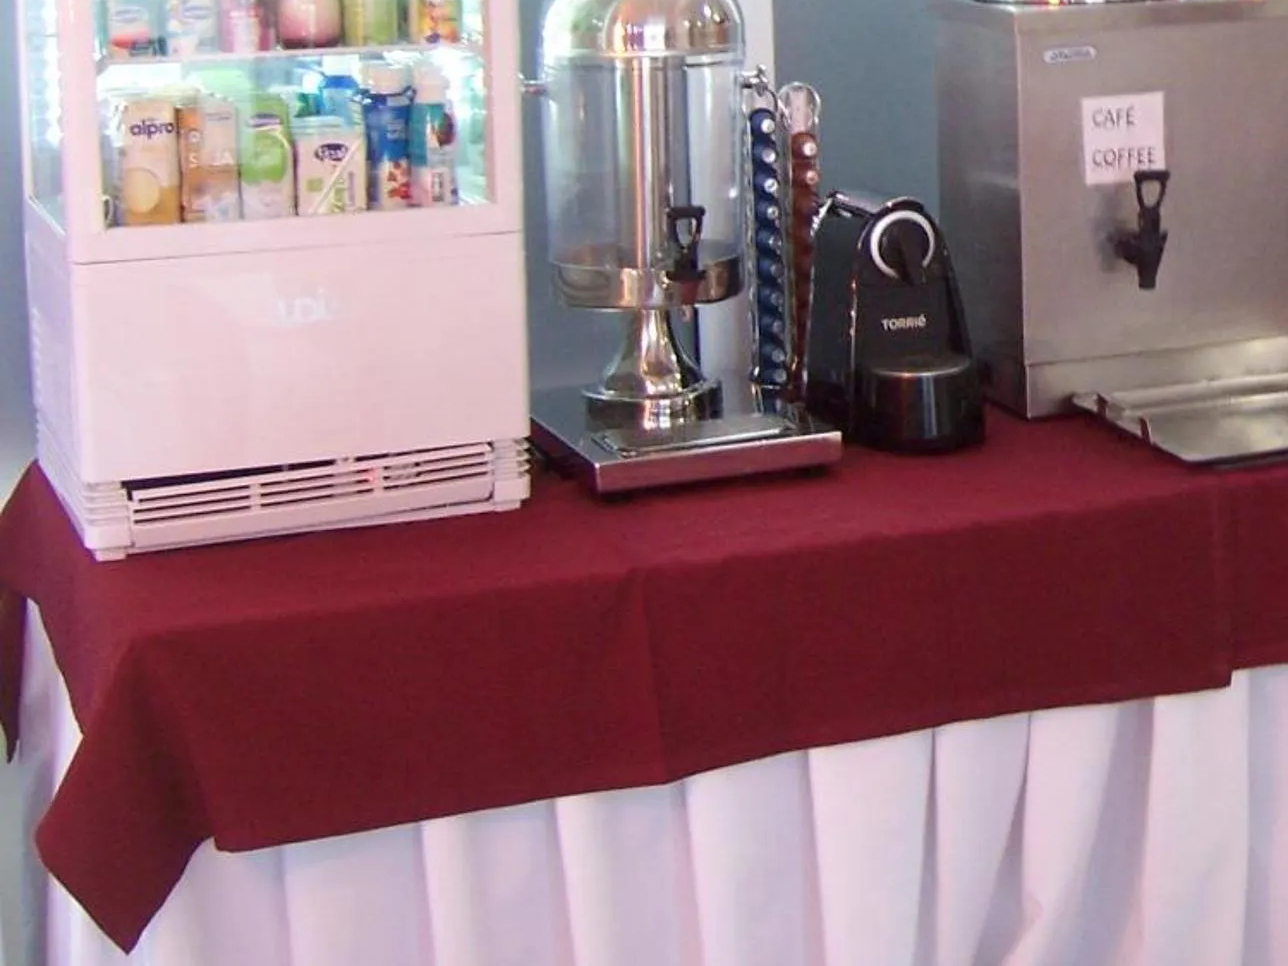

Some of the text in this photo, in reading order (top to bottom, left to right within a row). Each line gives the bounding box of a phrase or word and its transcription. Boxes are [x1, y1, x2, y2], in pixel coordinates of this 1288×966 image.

[1092, 104, 1135, 129] CAFÉ
[130, 120, 175, 139] alpro
[1092, 146, 1156, 169] COFFEE
